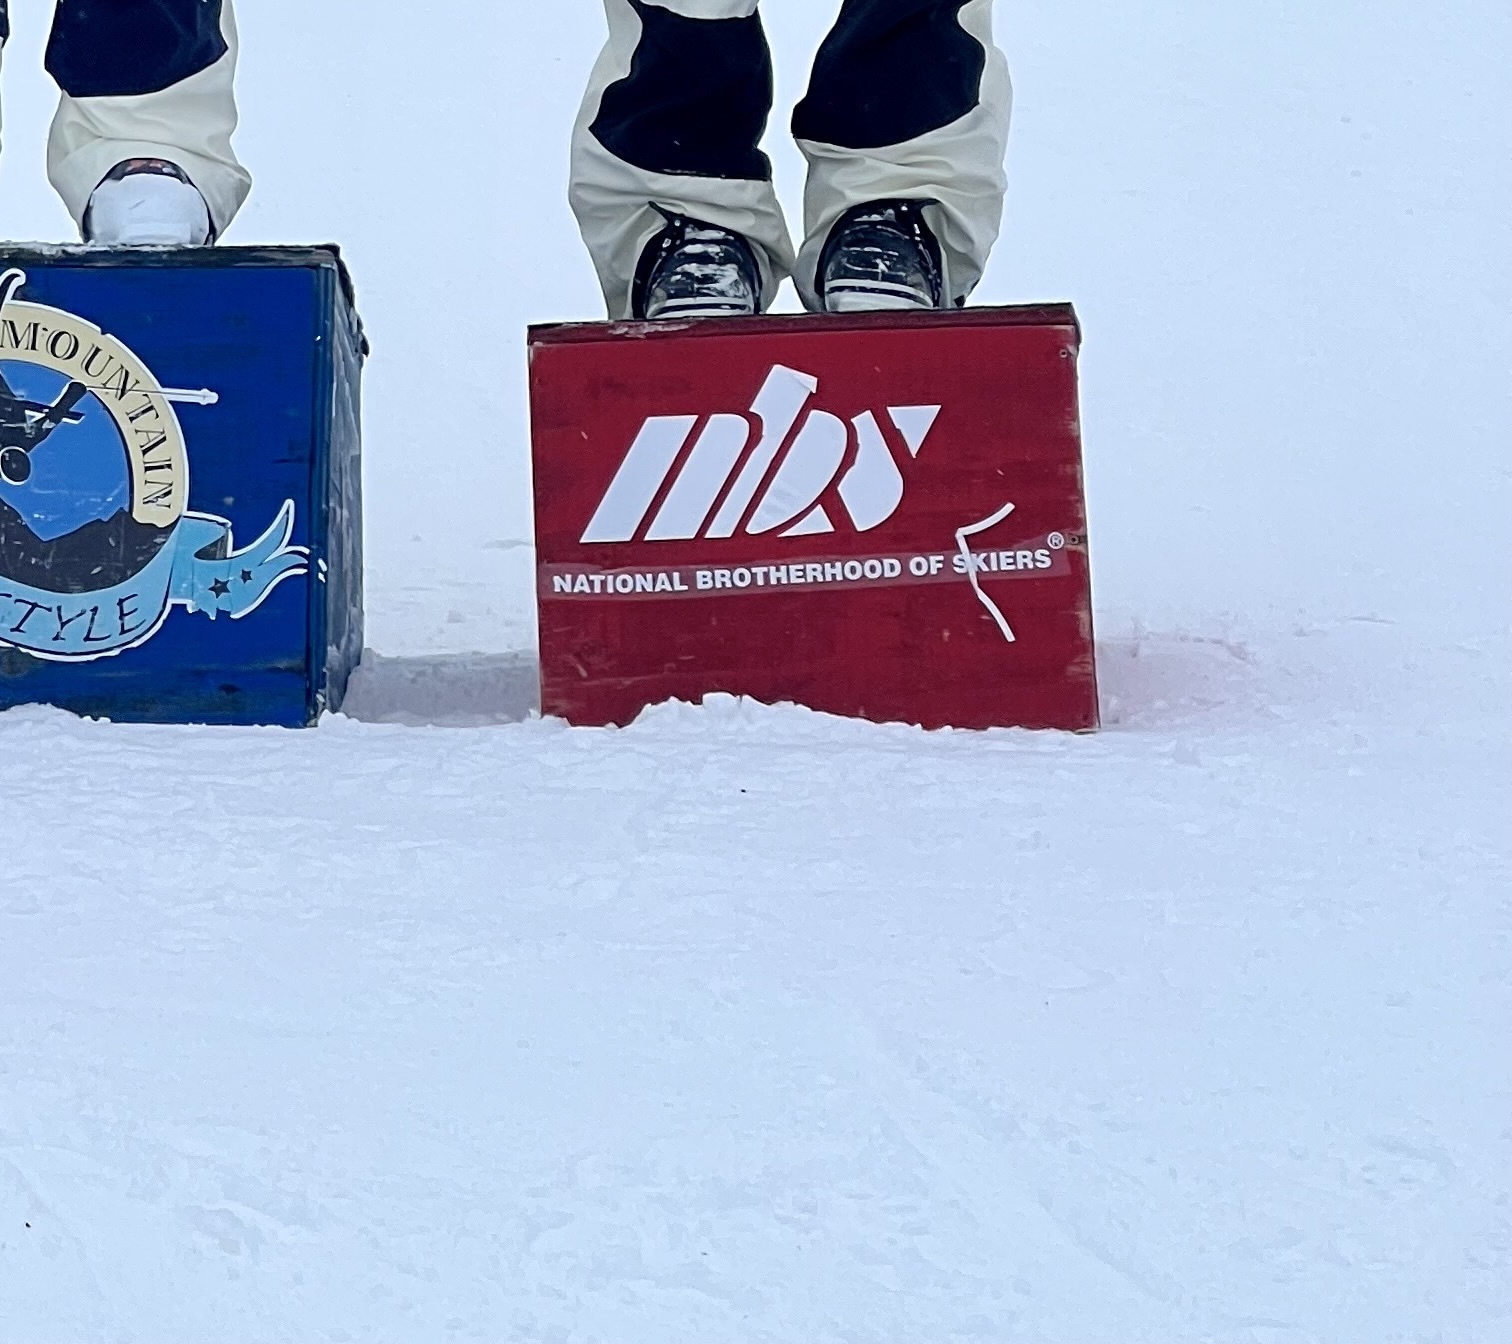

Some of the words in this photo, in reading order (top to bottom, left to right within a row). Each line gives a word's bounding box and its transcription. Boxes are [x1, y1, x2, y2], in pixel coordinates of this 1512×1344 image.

[553, 571, 688, 595] NATIONAL
[695, 558, 901, 591] BROTHERHOOD
[908, 553, 945, 577] OF
[952, 548, 1053, 575] SKIERS
